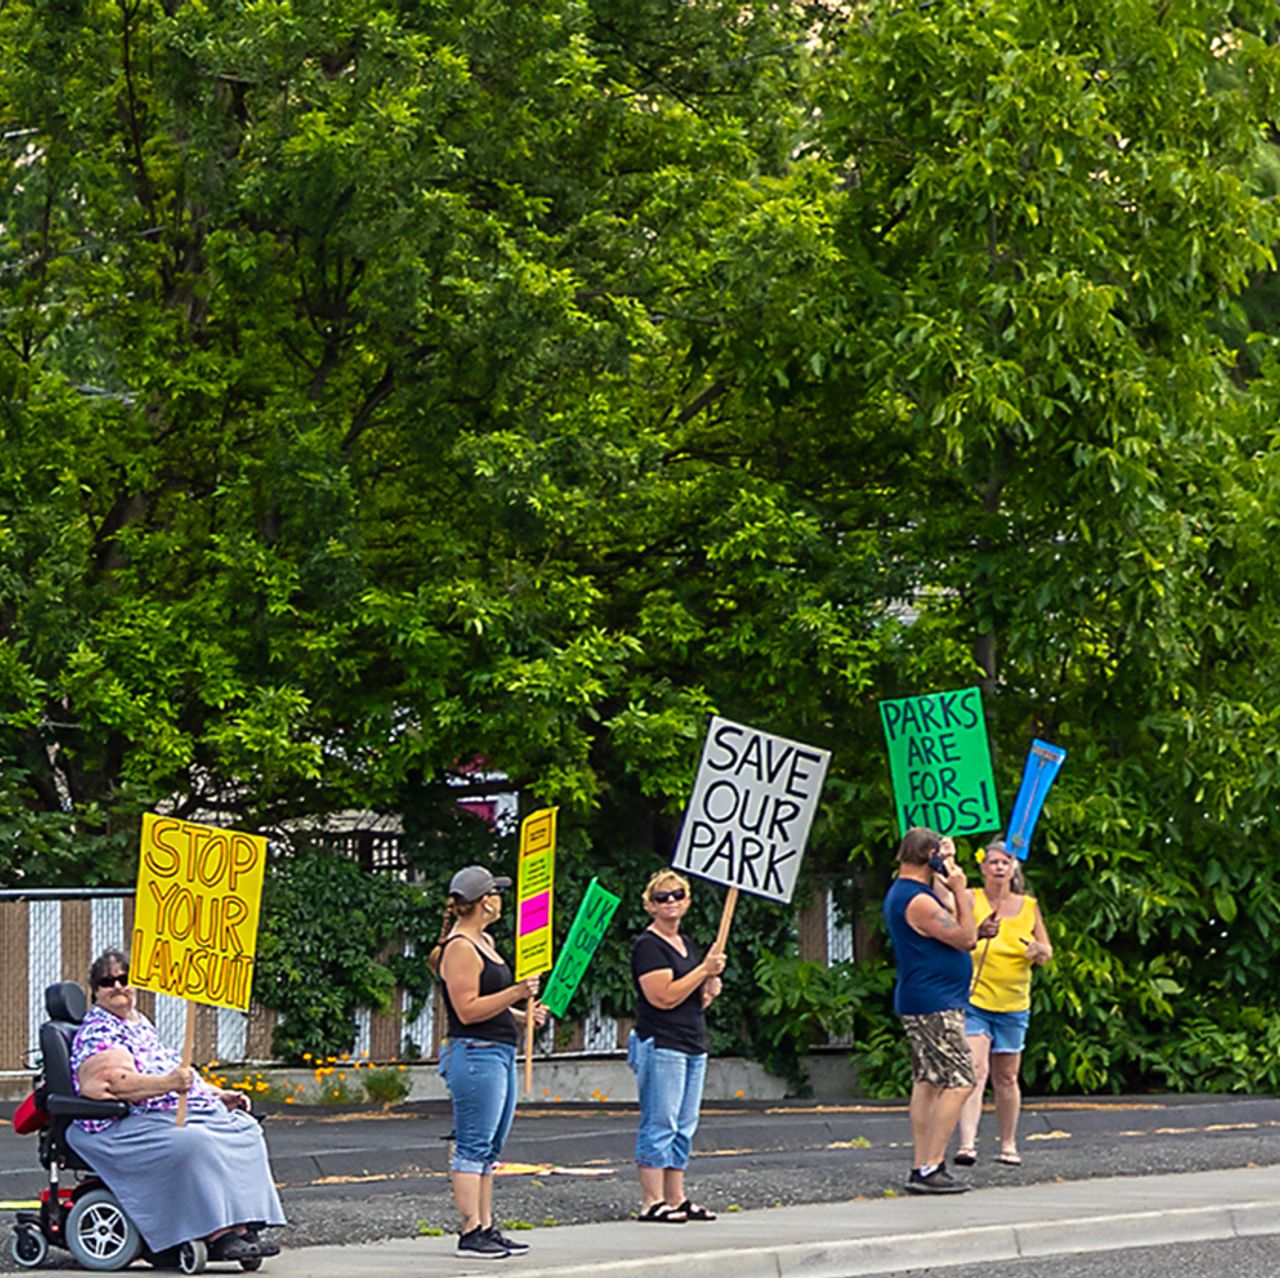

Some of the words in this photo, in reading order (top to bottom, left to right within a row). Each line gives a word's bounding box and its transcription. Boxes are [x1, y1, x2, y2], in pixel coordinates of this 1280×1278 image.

[883, 692, 978, 740] PARKS
[908, 732, 961, 767] ARE
[707, 726, 822, 800] SAVE
[908, 767, 961, 802] FOR
[703, 780, 801, 842] OUR
[903, 780, 993, 836] KIDS!
[144, 818, 258, 891] STOP
[686, 821, 796, 894] PARK
[149, 880, 249, 953] YOUR
[131, 928, 253, 1010] LAWSUIT
